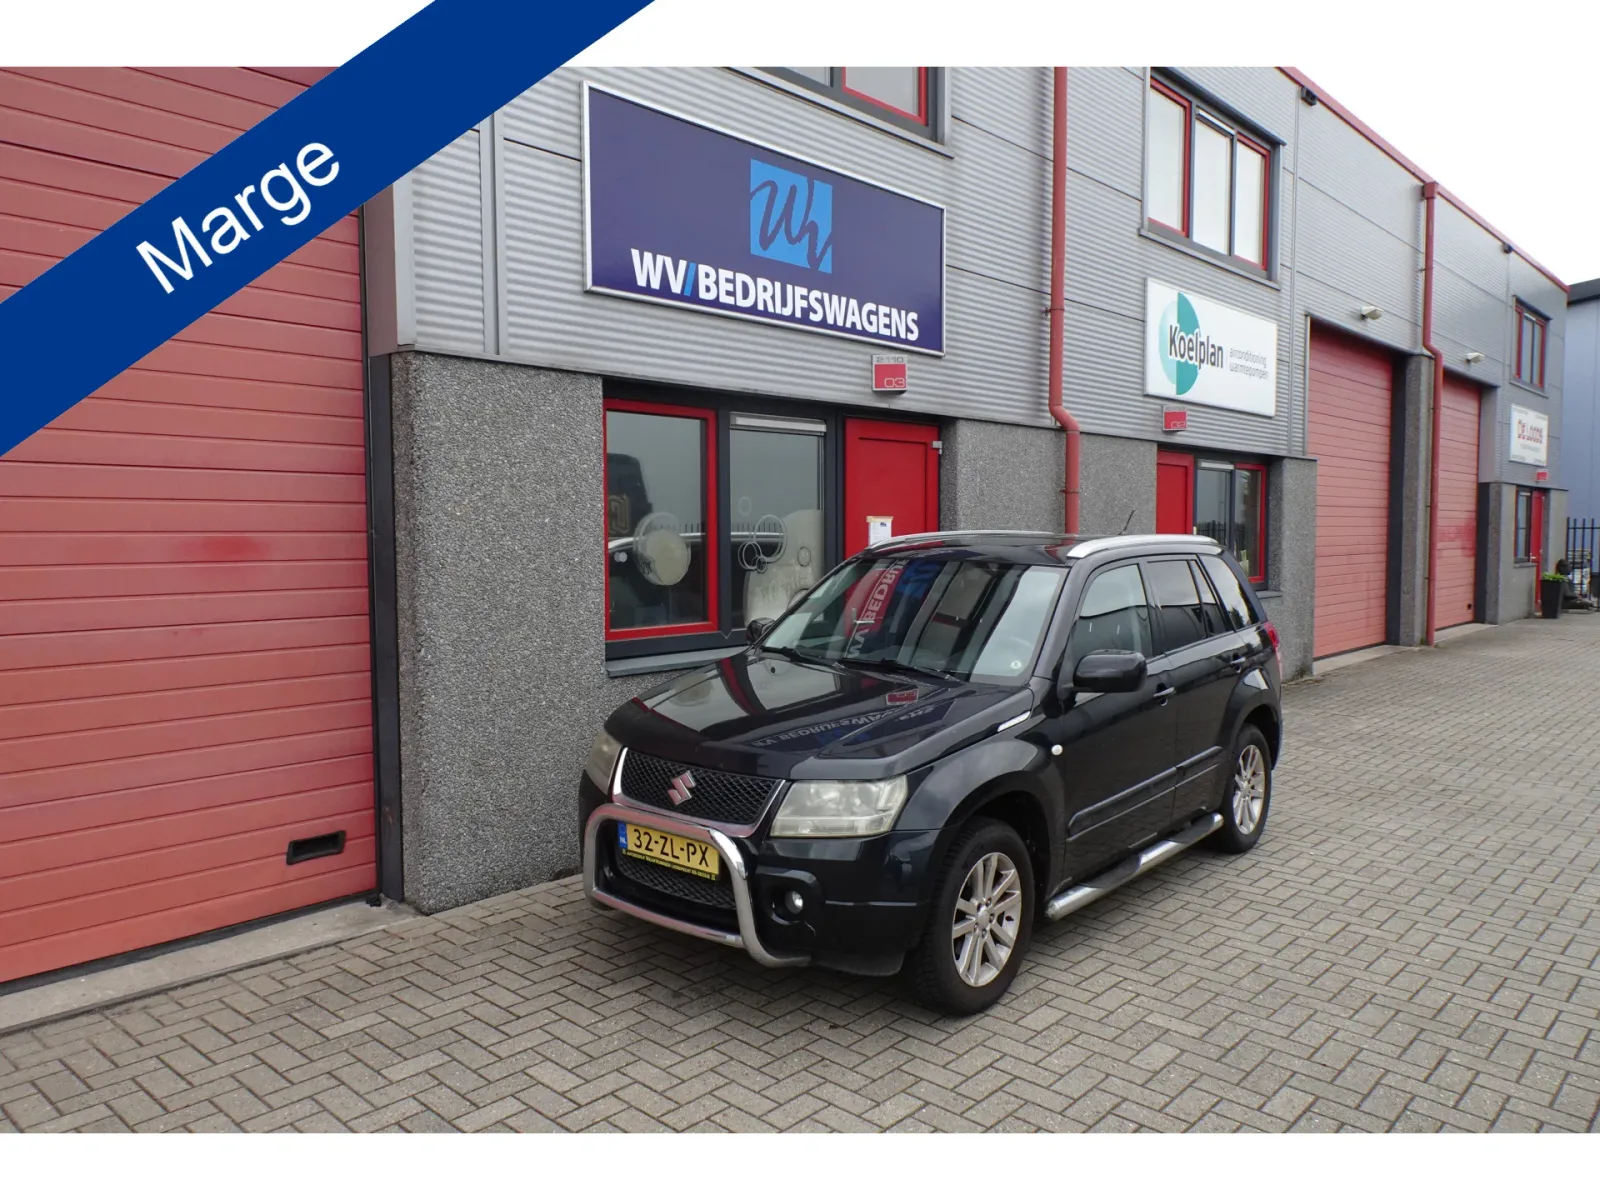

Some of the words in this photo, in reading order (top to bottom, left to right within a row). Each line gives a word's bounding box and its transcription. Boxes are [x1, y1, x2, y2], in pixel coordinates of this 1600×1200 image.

[1169, 324, 1224, 370] Koelplan
[1229, 347, 1267, 368] airconditioning
[1229, 362, 1270, 381] warmtepompen
[884, 377, 905, 388] 03
[633, 828, 709, 868] 32-ZL-PX
